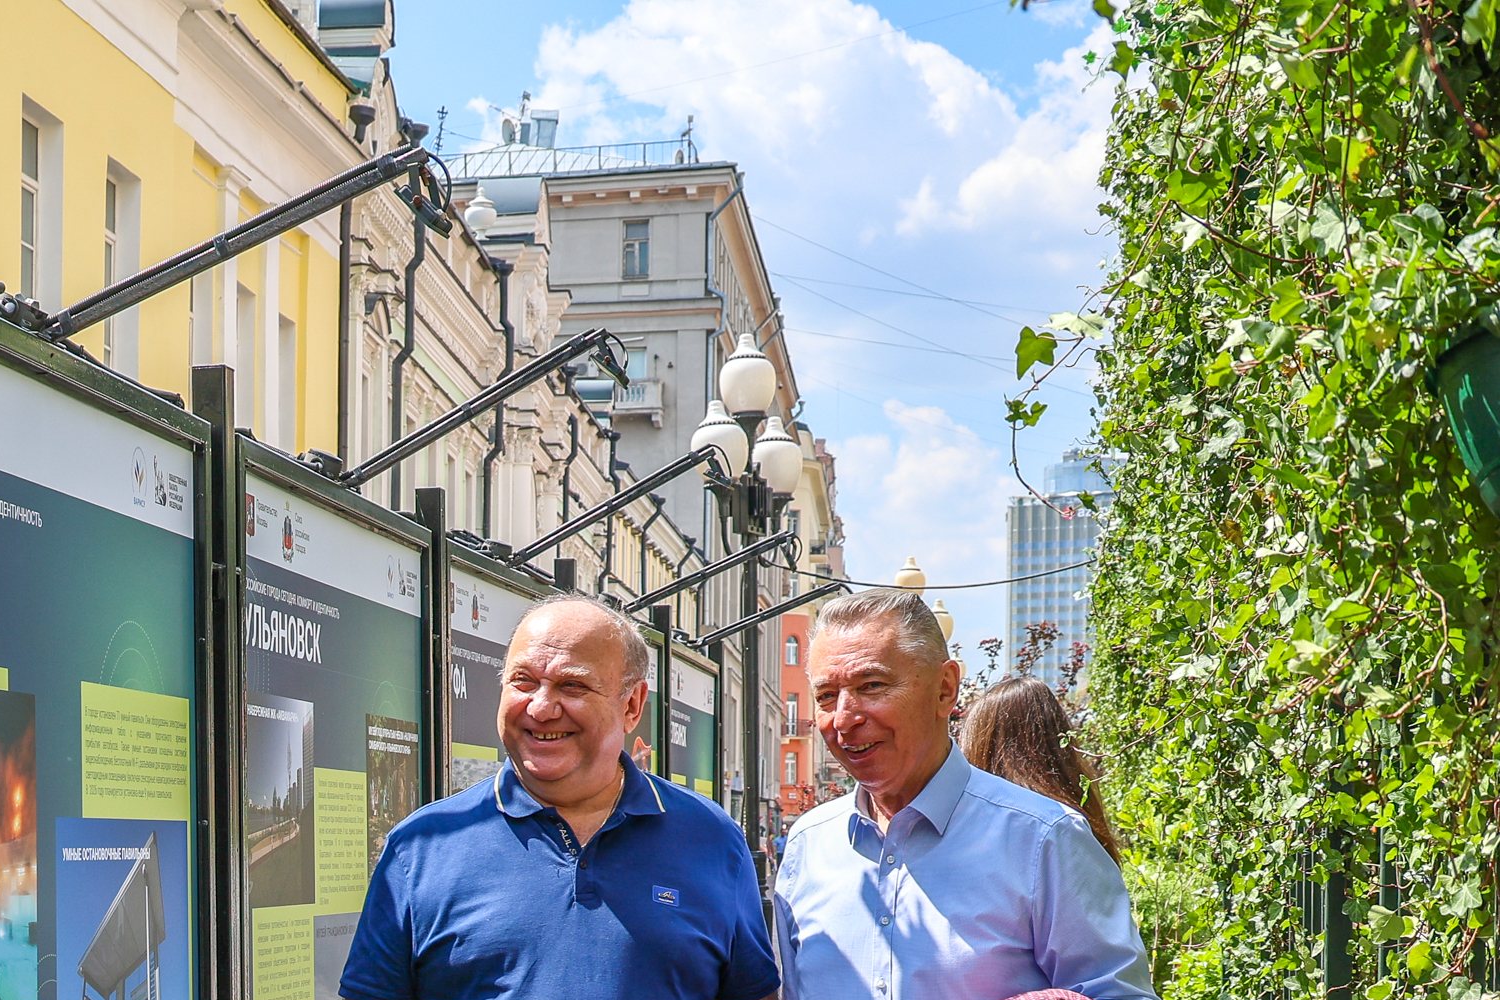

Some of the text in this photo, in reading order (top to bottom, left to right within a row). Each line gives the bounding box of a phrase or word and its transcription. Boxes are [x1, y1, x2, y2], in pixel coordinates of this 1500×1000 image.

[246, 576, 267, 596] ОССИЙСКИЕ
[452, 666, 467, 700] ФА
[62, 848, 81, 861] УМНЫЕ
[82, 848, 121, 861] ОСТАНОВОЧНЫЕ
